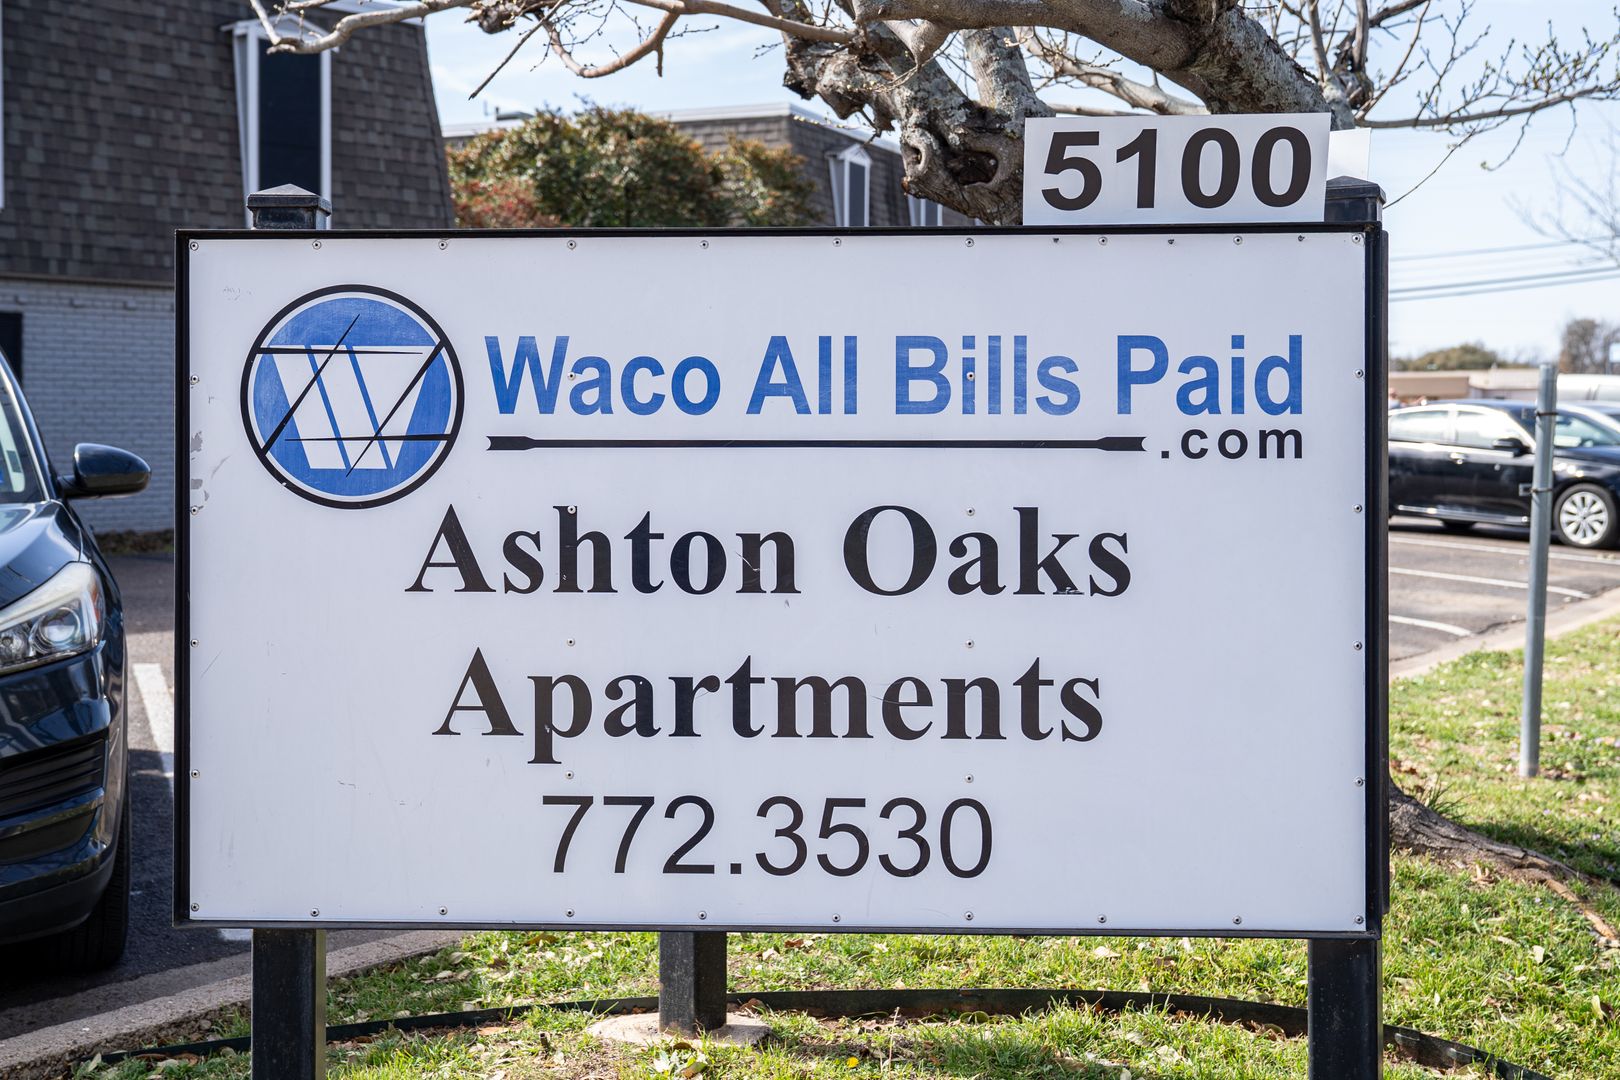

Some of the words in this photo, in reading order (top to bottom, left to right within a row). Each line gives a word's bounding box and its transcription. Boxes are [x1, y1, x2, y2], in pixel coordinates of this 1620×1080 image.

[1042, 127, 1311, 211] 5100
[485, 336, 720, 415] Waco
[746, 336, 857, 414] All
[896, 336, 1080, 415] Bills
[1118, 335, 1302, 415] Paid
[1161, 429, 1302, 459] .com
[405, 504, 801, 595] Ashton
[844, 506, 1131, 597] Oaks
[432, 647, 1102, 764] Apartments
[543, 795, 992, 878] 772.3530
